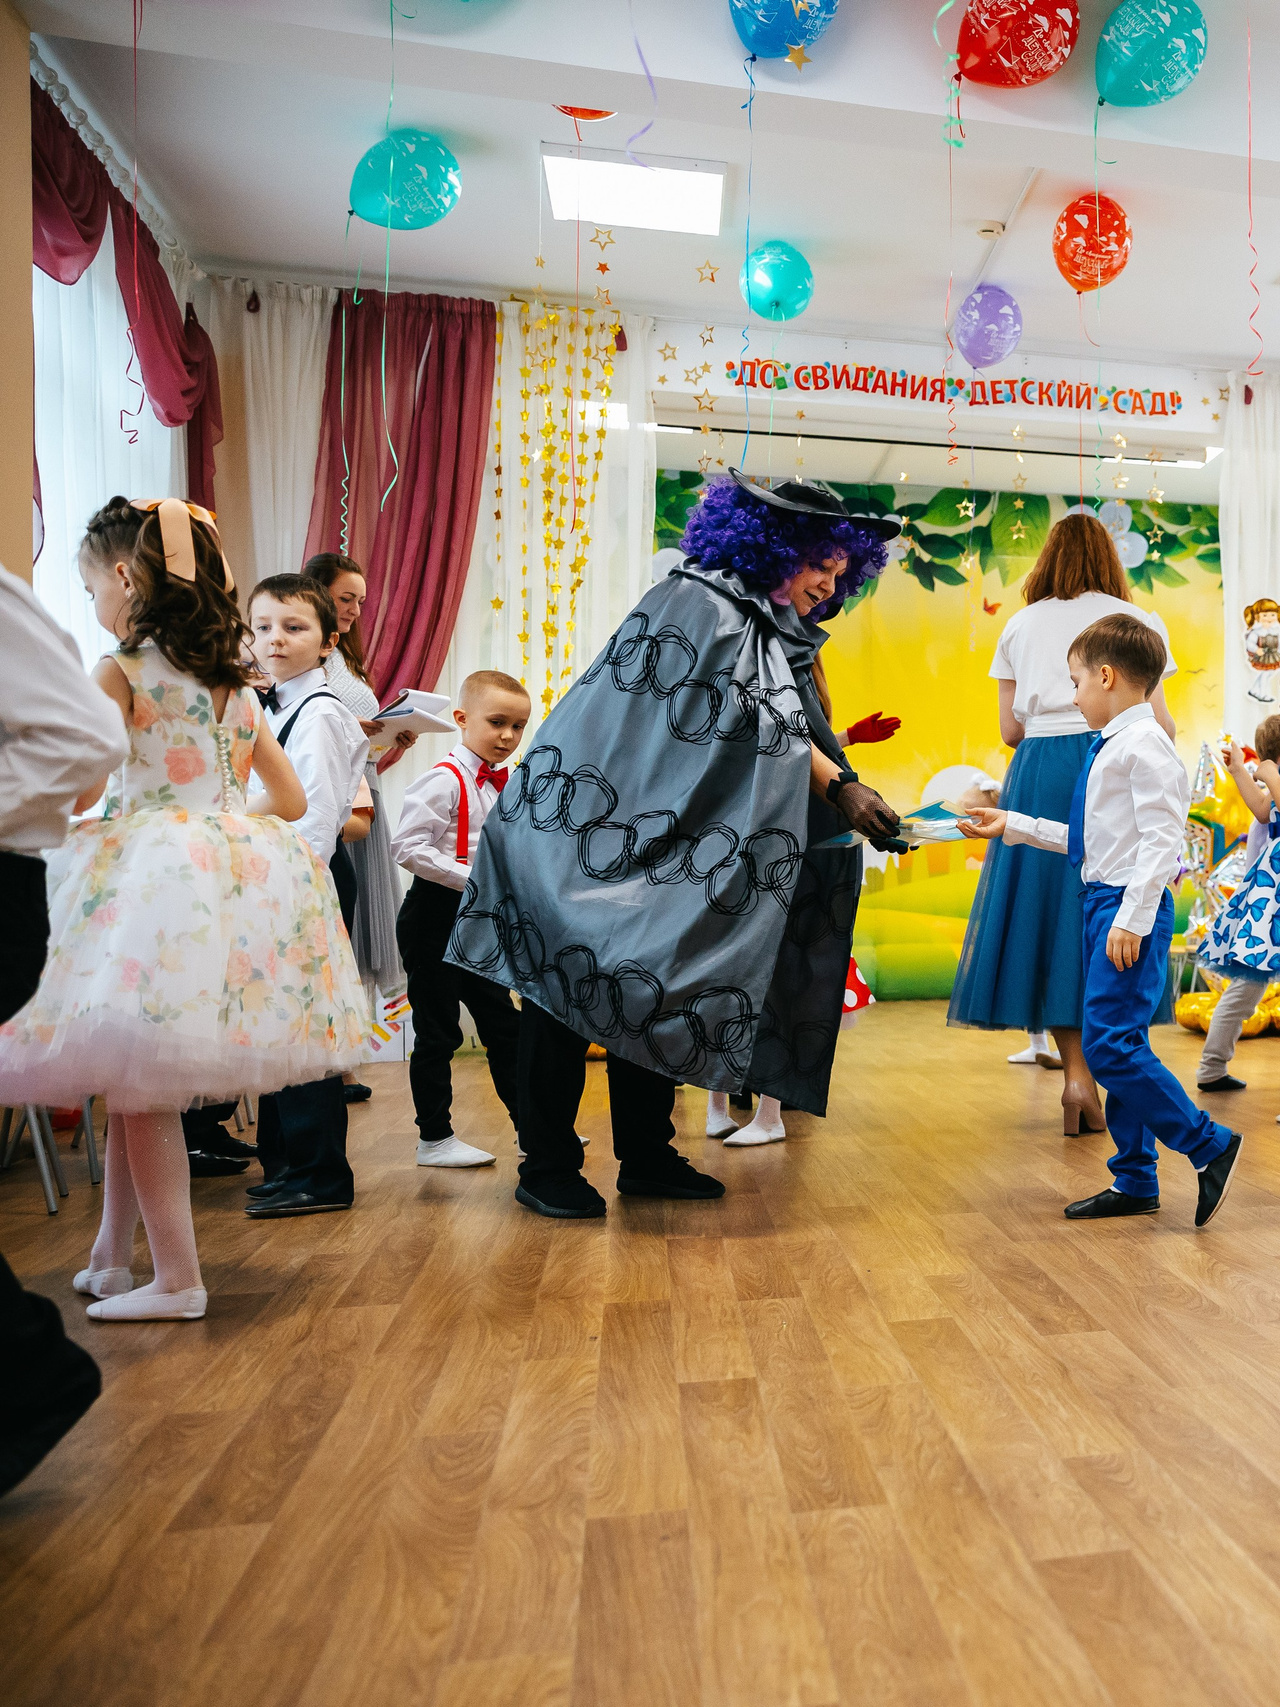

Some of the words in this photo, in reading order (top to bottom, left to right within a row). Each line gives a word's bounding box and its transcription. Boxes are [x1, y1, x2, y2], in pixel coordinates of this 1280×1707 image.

[734, 360, 779, 389] ДО
[968, 379, 1092, 410] ДЕТСКИЙ
[1113, 389, 1178, 416] САД!
